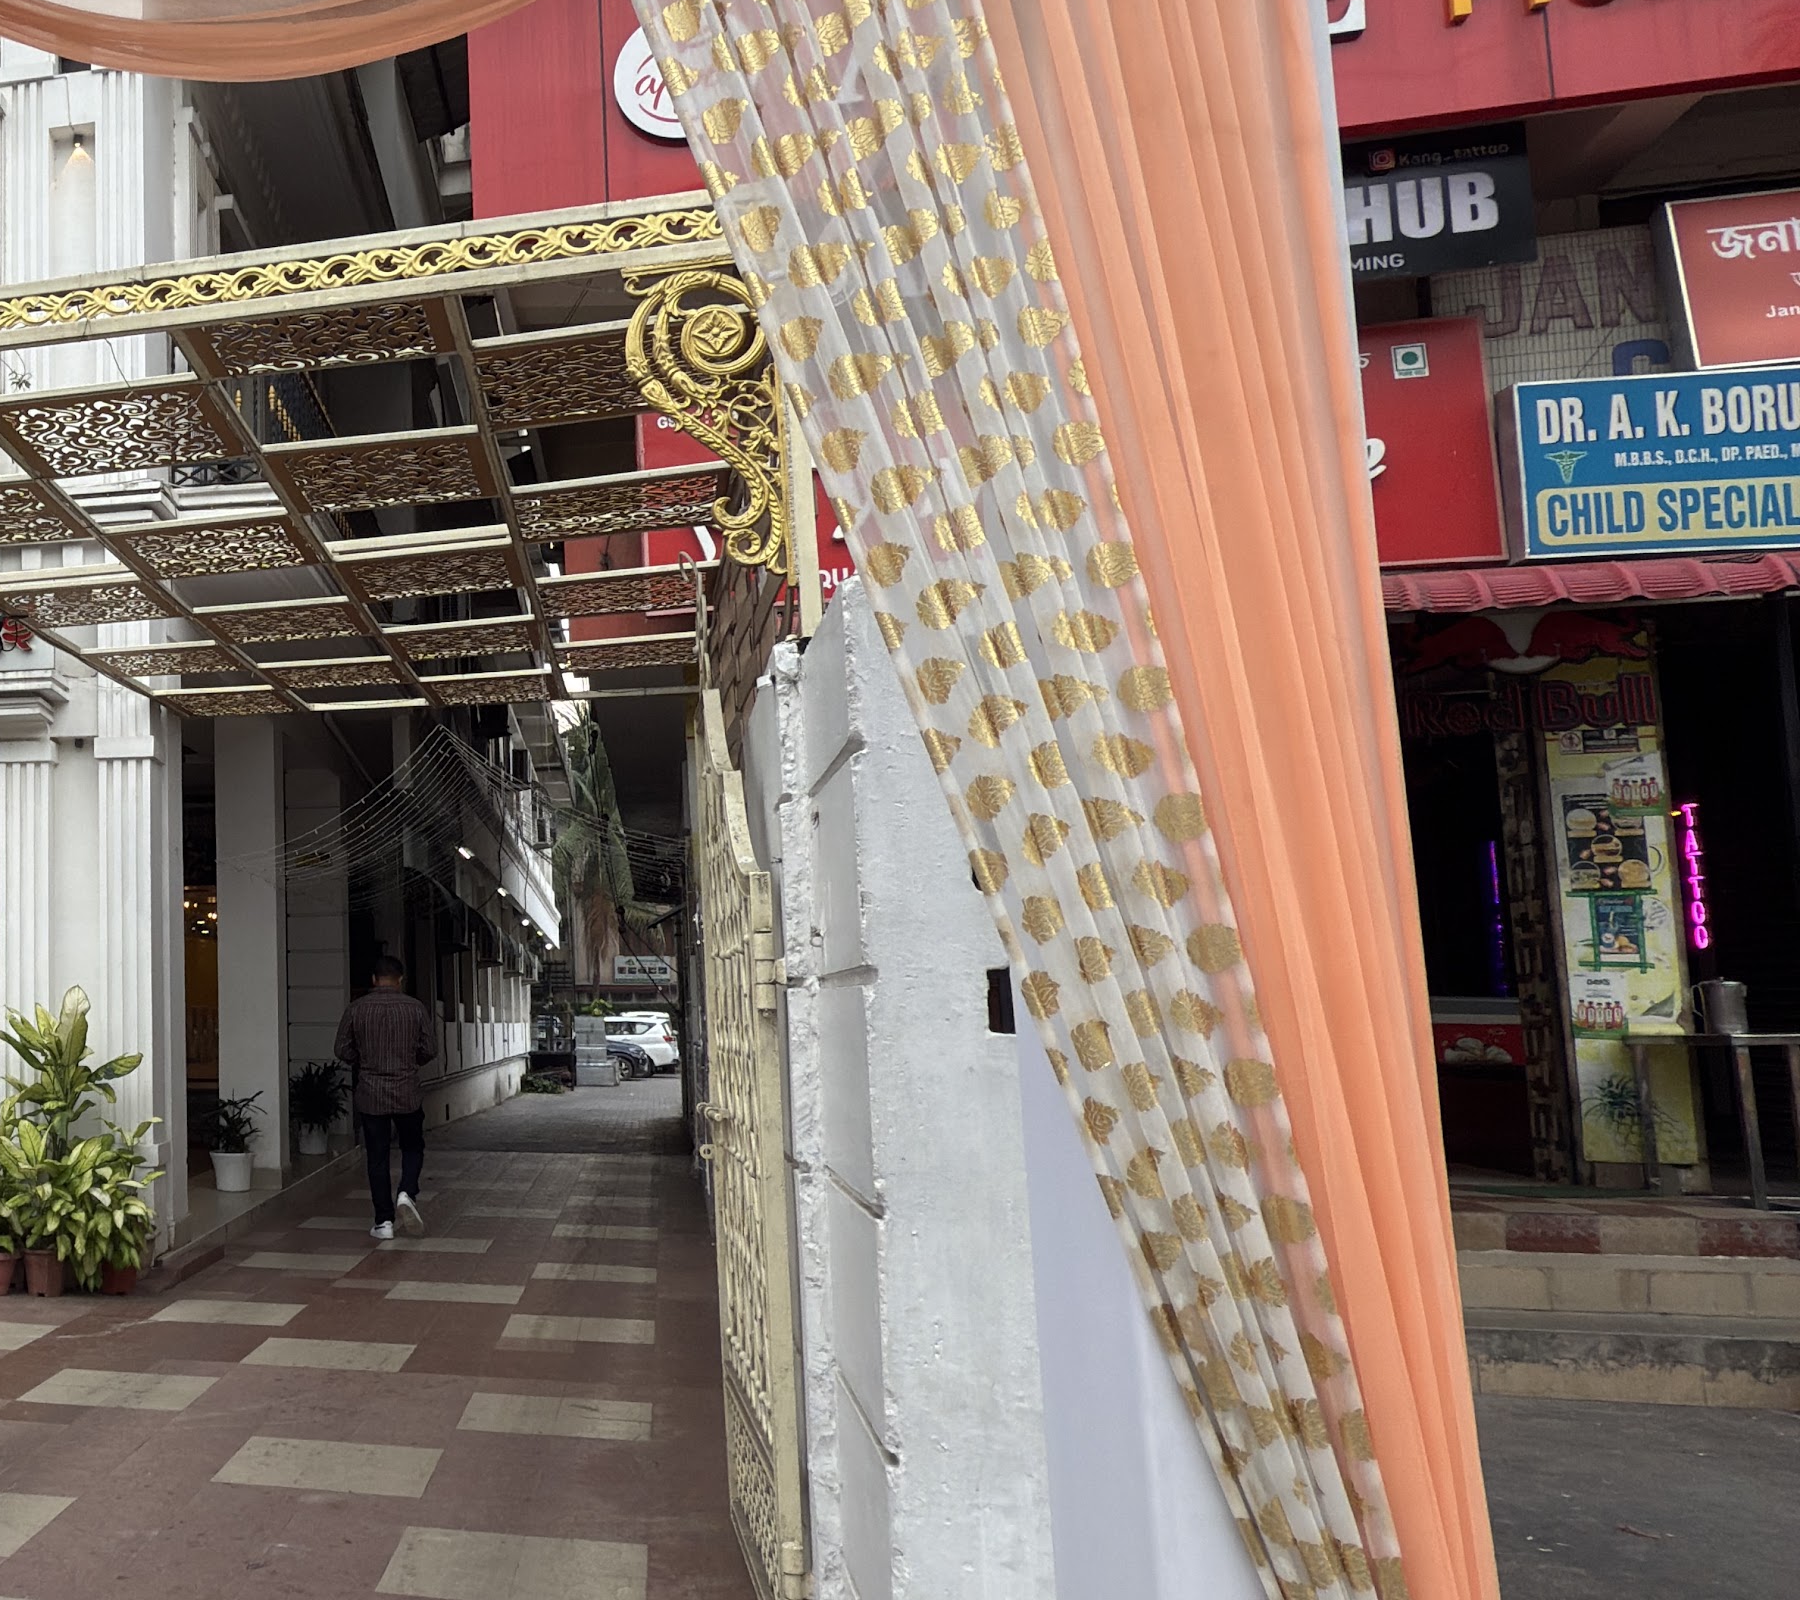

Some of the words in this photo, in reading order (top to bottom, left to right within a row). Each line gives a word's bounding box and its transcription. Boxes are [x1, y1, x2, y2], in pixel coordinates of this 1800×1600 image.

[1343, 171, 1499, 245] HUB
[1535, 396, 1597, 445] DR.
[1608, 393, 1645, 440] A.
[1655, 390, 1691, 438] K.
[1547, 490, 1645, 537] CHILD
[1403, 679, 1526, 737] Red
[1535, 672, 1658, 731] Bull
[1682, 802, 1709, 950] TATTOO
